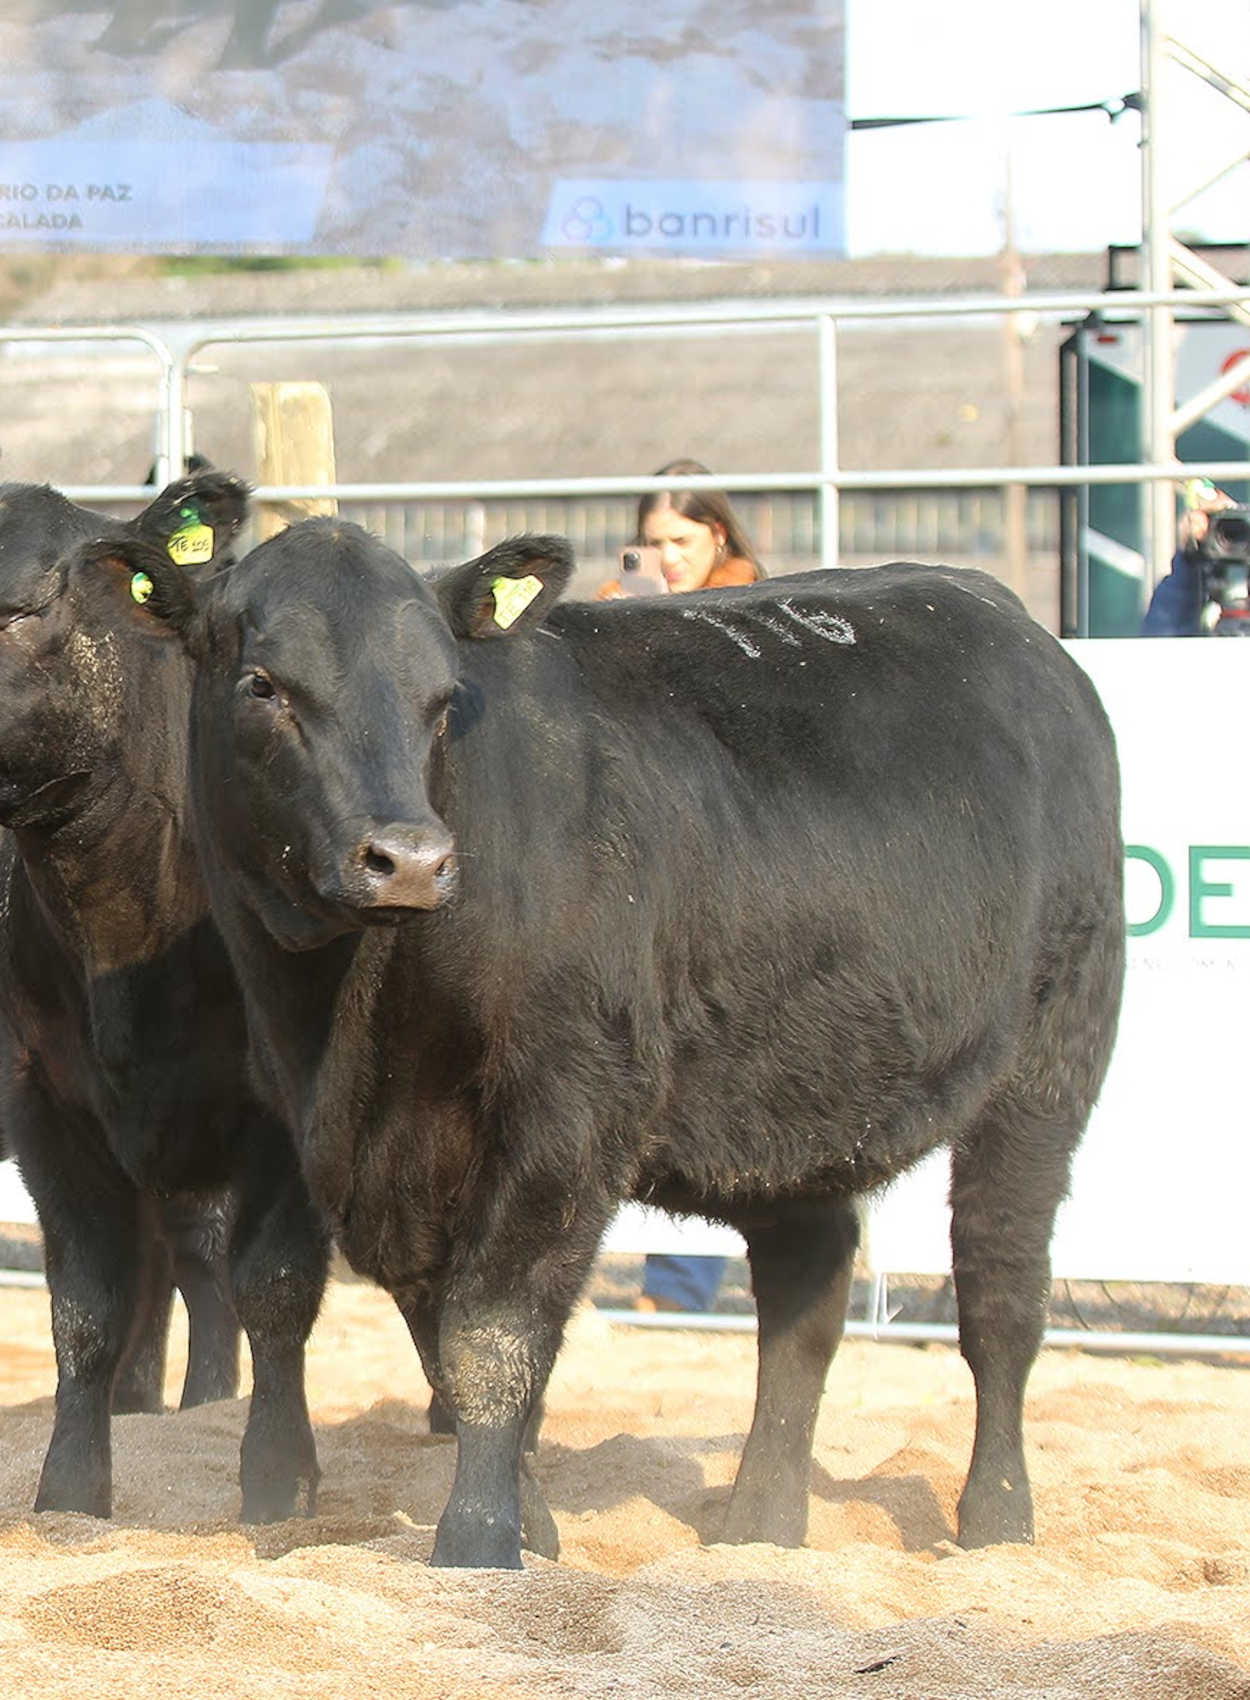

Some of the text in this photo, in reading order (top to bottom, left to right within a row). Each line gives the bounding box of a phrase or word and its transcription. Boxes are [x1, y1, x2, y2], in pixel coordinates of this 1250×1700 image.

[46, 184, 79, 201] DA
[87, 184, 133, 201] PAZ
[625, 203, 821, 240] banrisul
